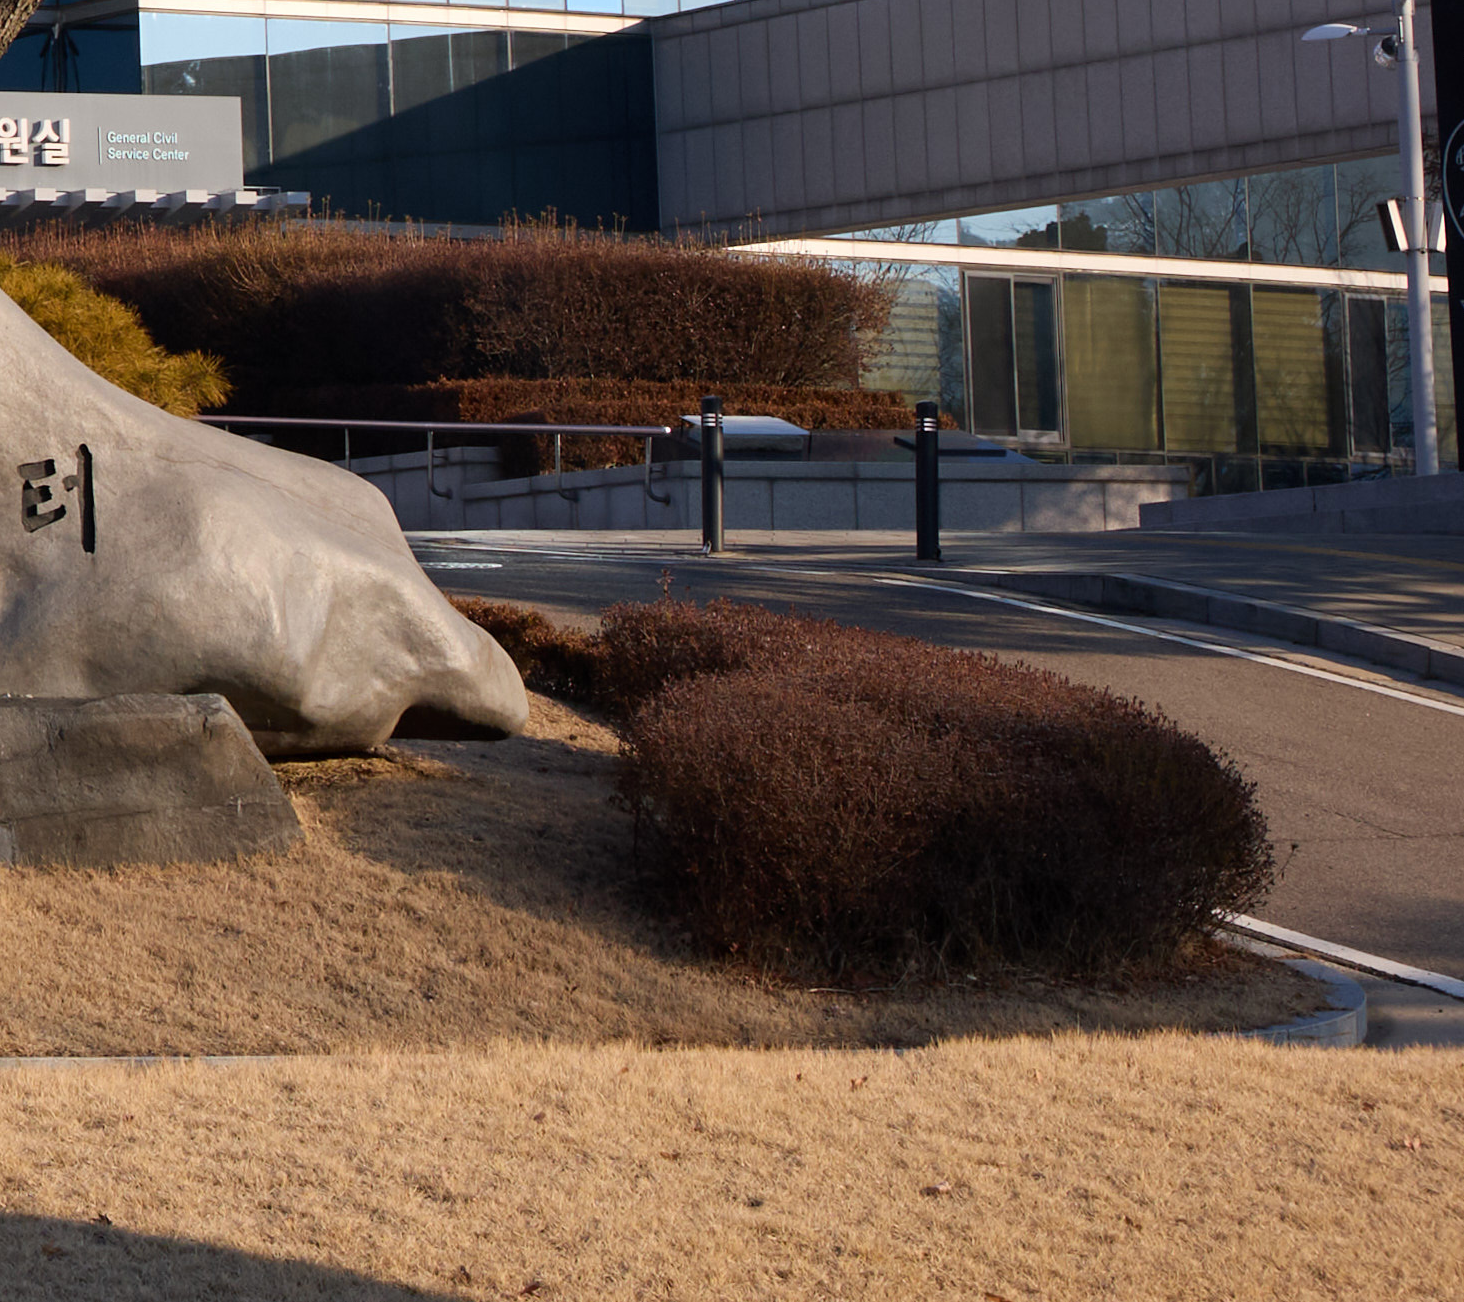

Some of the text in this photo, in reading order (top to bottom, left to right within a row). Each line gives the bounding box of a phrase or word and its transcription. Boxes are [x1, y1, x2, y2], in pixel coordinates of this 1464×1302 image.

[107, 130, 178, 144] General Civil
[107, 147, 190, 160] Service Center
[16, 443, 96, 555] 터
